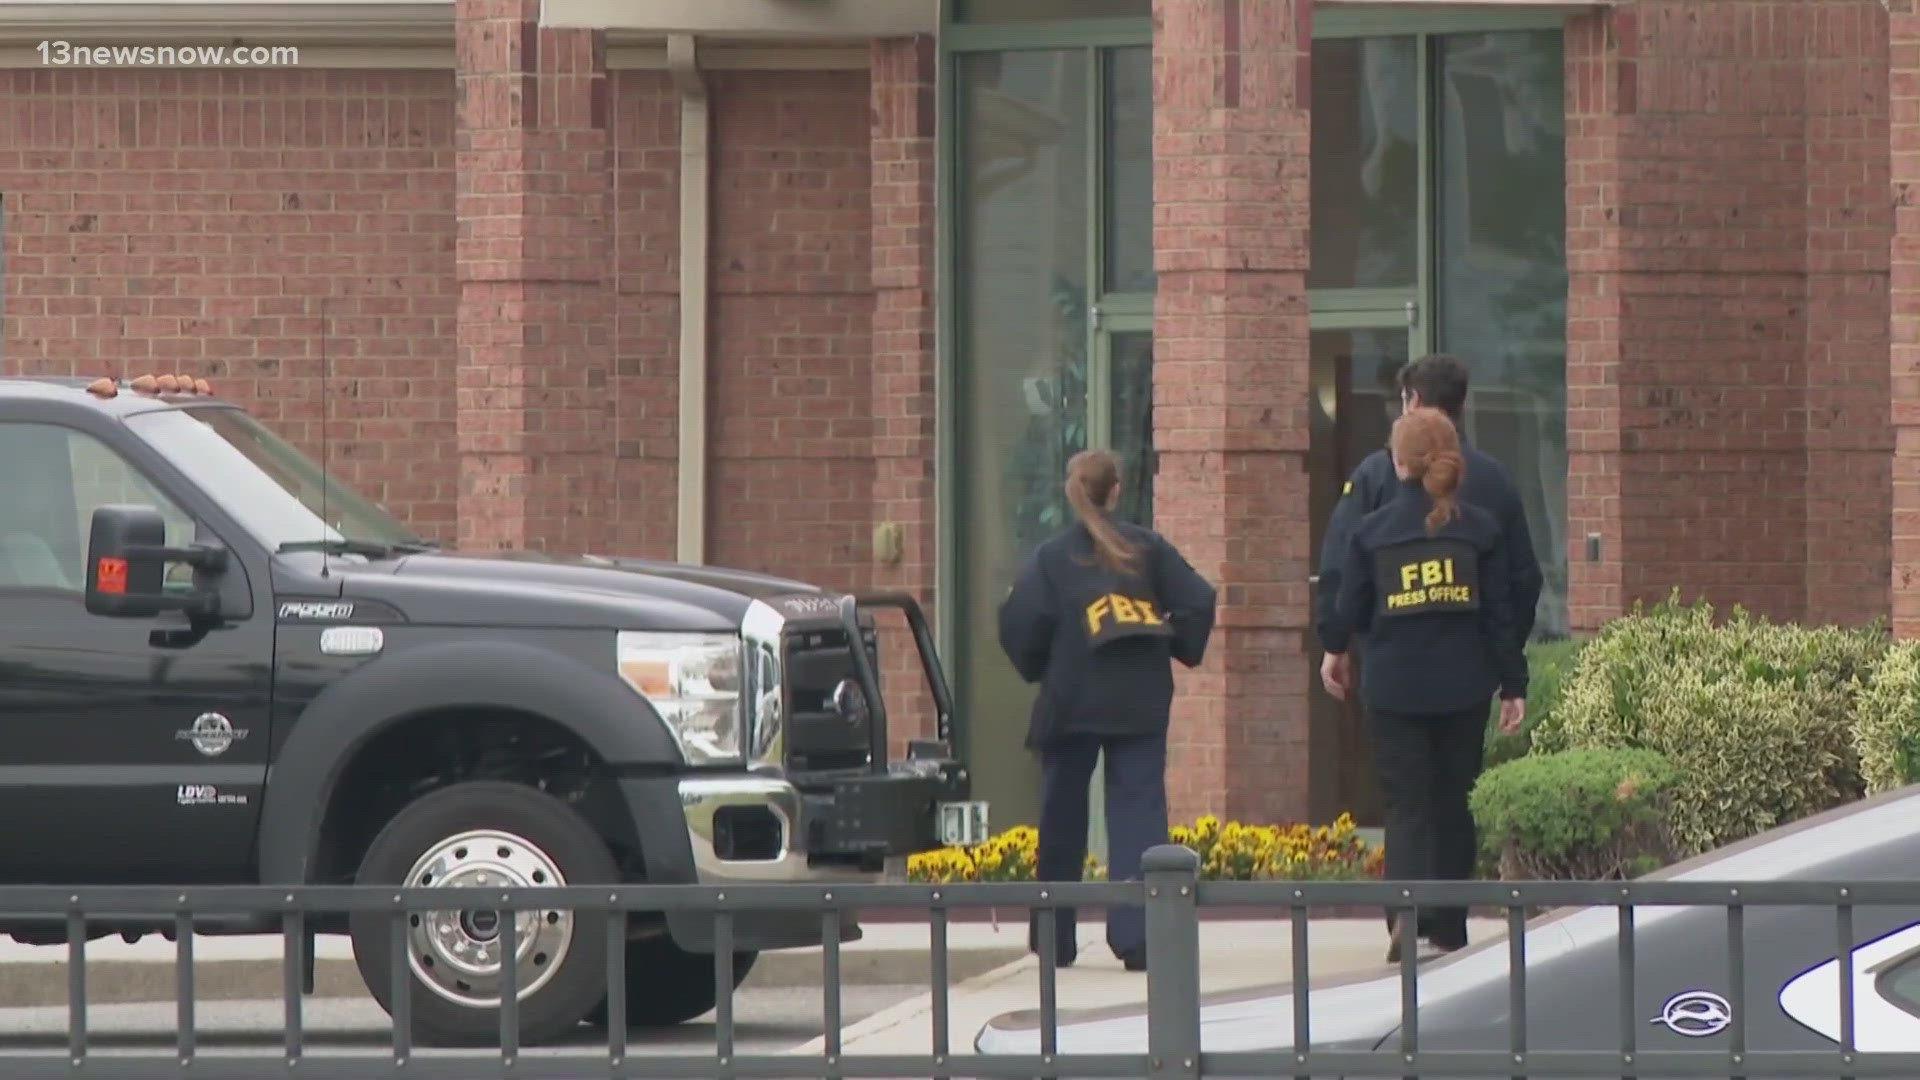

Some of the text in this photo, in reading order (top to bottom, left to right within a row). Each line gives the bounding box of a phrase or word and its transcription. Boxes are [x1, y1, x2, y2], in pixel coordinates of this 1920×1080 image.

[1401, 558, 1454, 590] FBI
[1087, 593, 1163, 635] FBI
[1387, 586, 1470, 610] PRESS OFFICE
